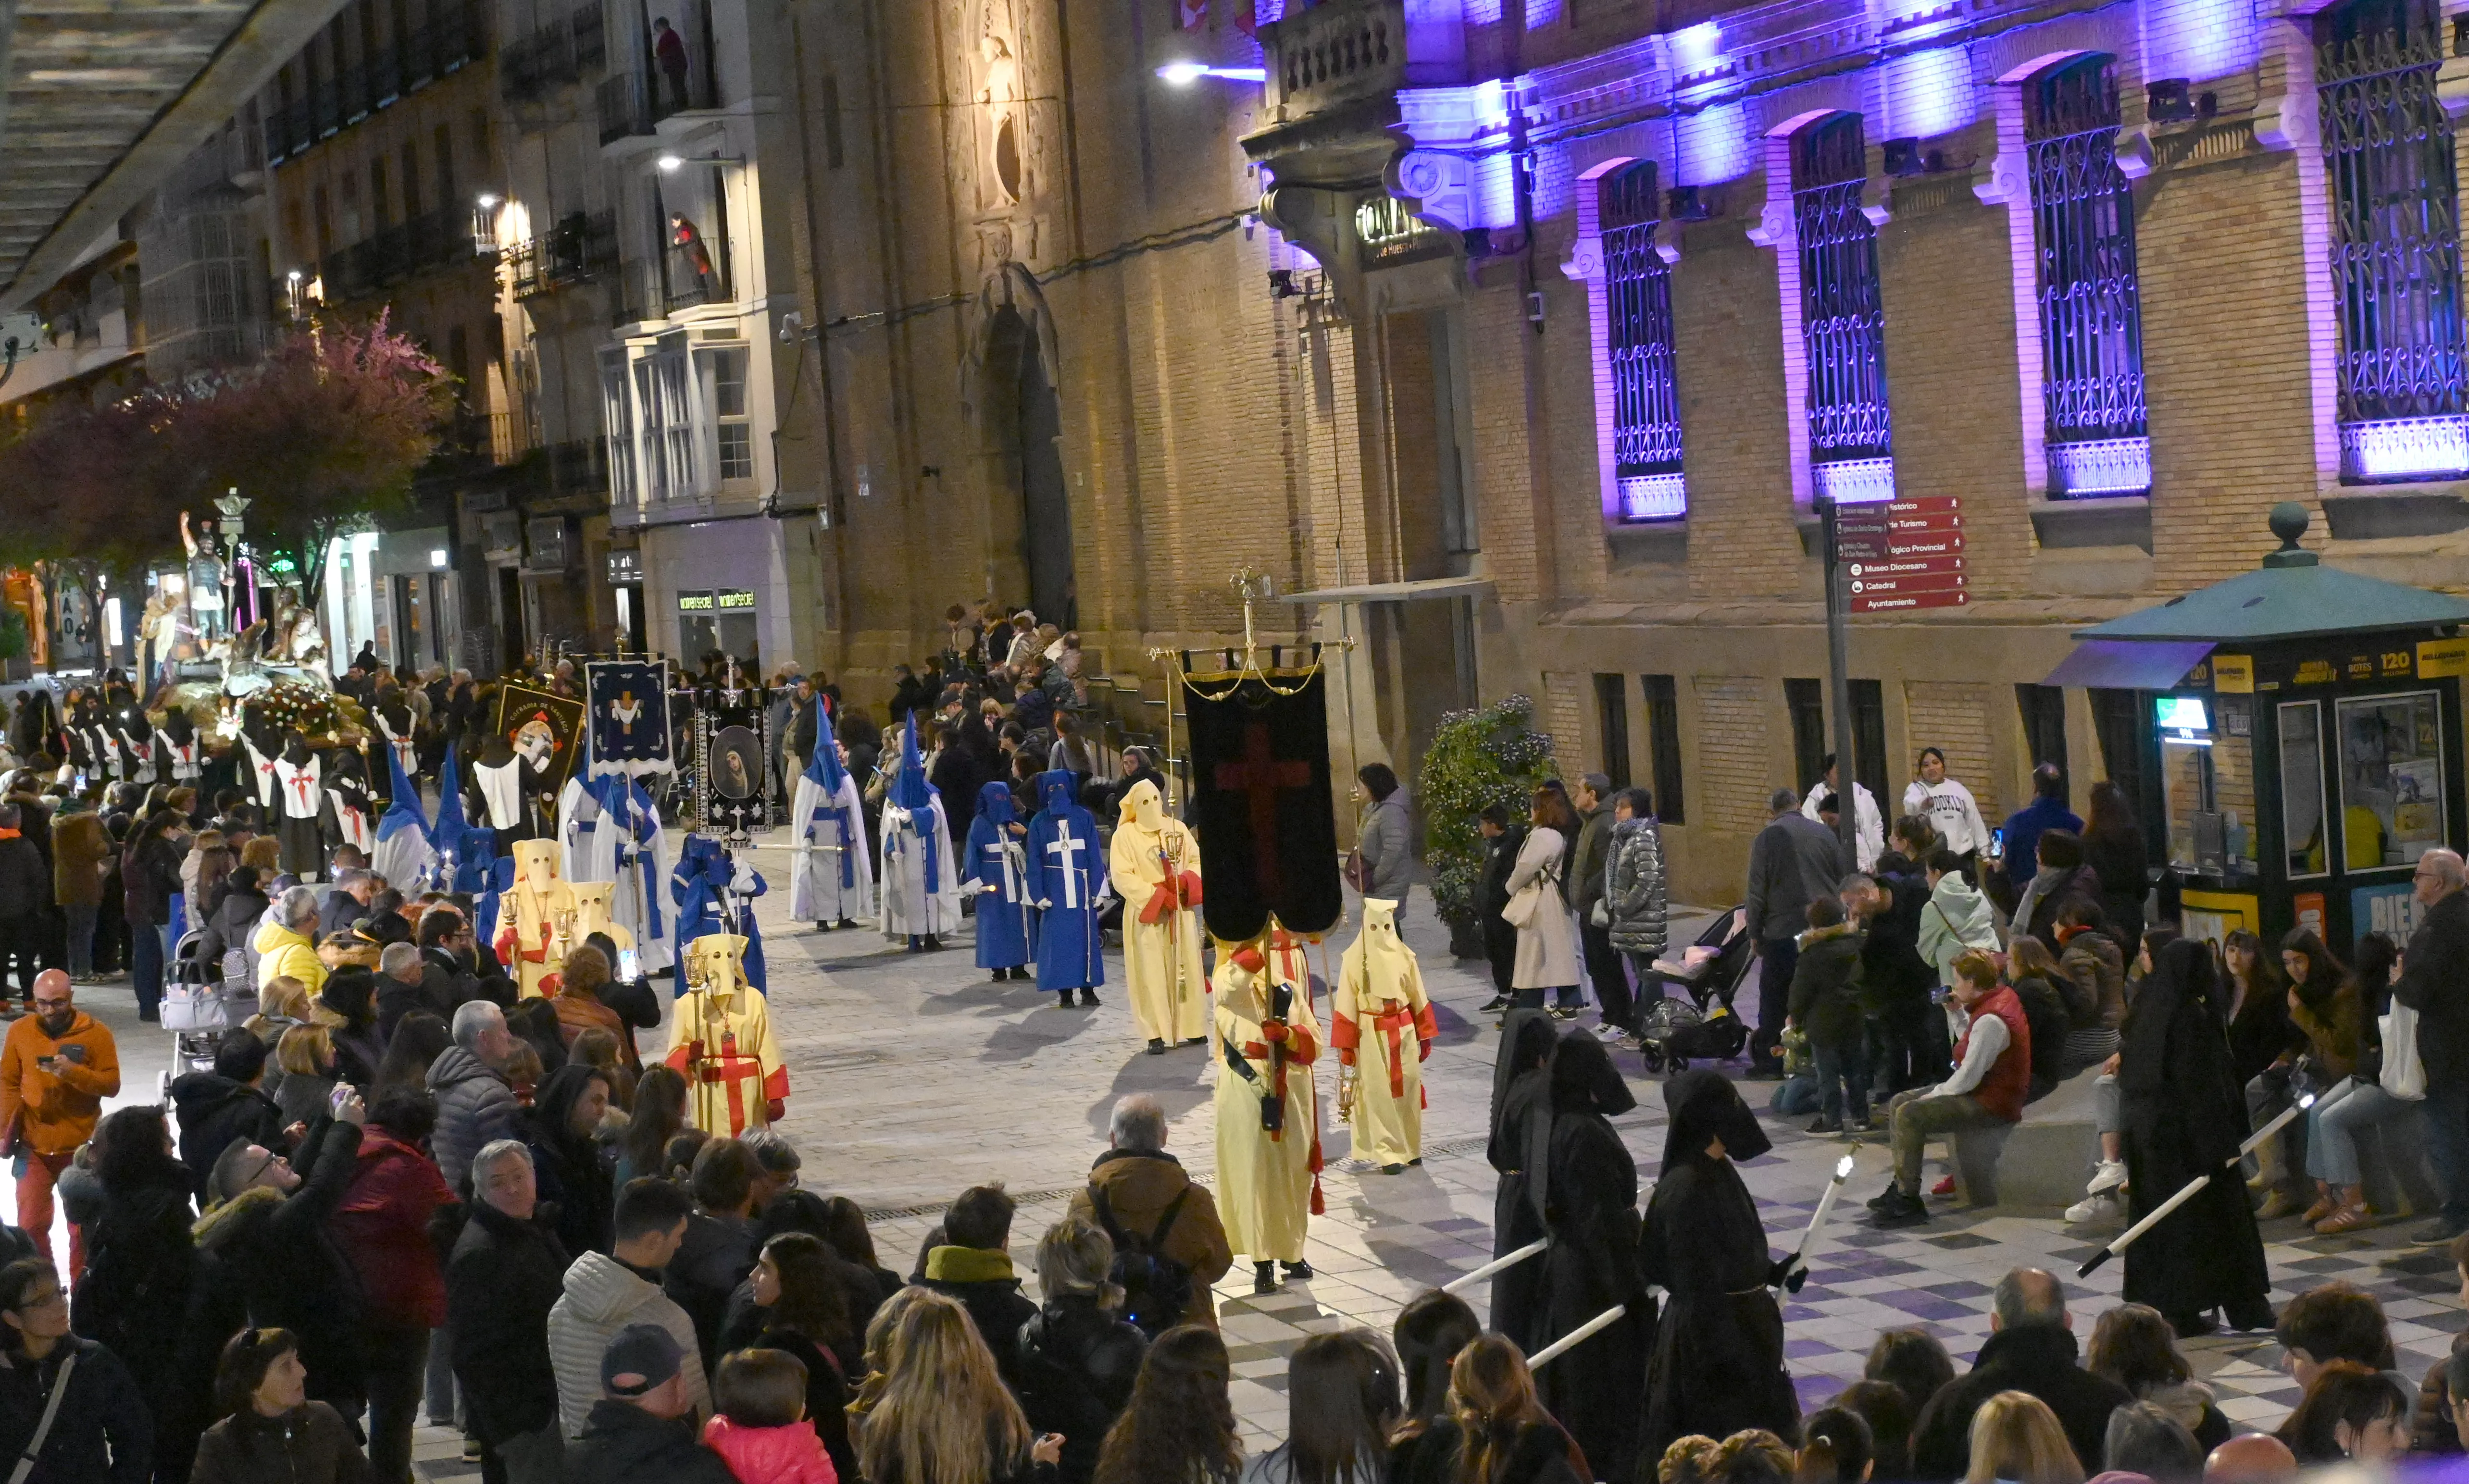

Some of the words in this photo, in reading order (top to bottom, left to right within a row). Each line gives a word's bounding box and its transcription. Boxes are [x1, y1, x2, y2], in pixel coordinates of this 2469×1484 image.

[1891, 546, 1910, 555] ógico
[1912, 544, 1945, 552] Provincial
[1890, 562, 1927, 571] Diocesano
[1868, 599, 1916, 608] Ayuntamiento
[2381, 652, 2410, 669] 120
[550, 705, 569, 734] SANTIAGO
